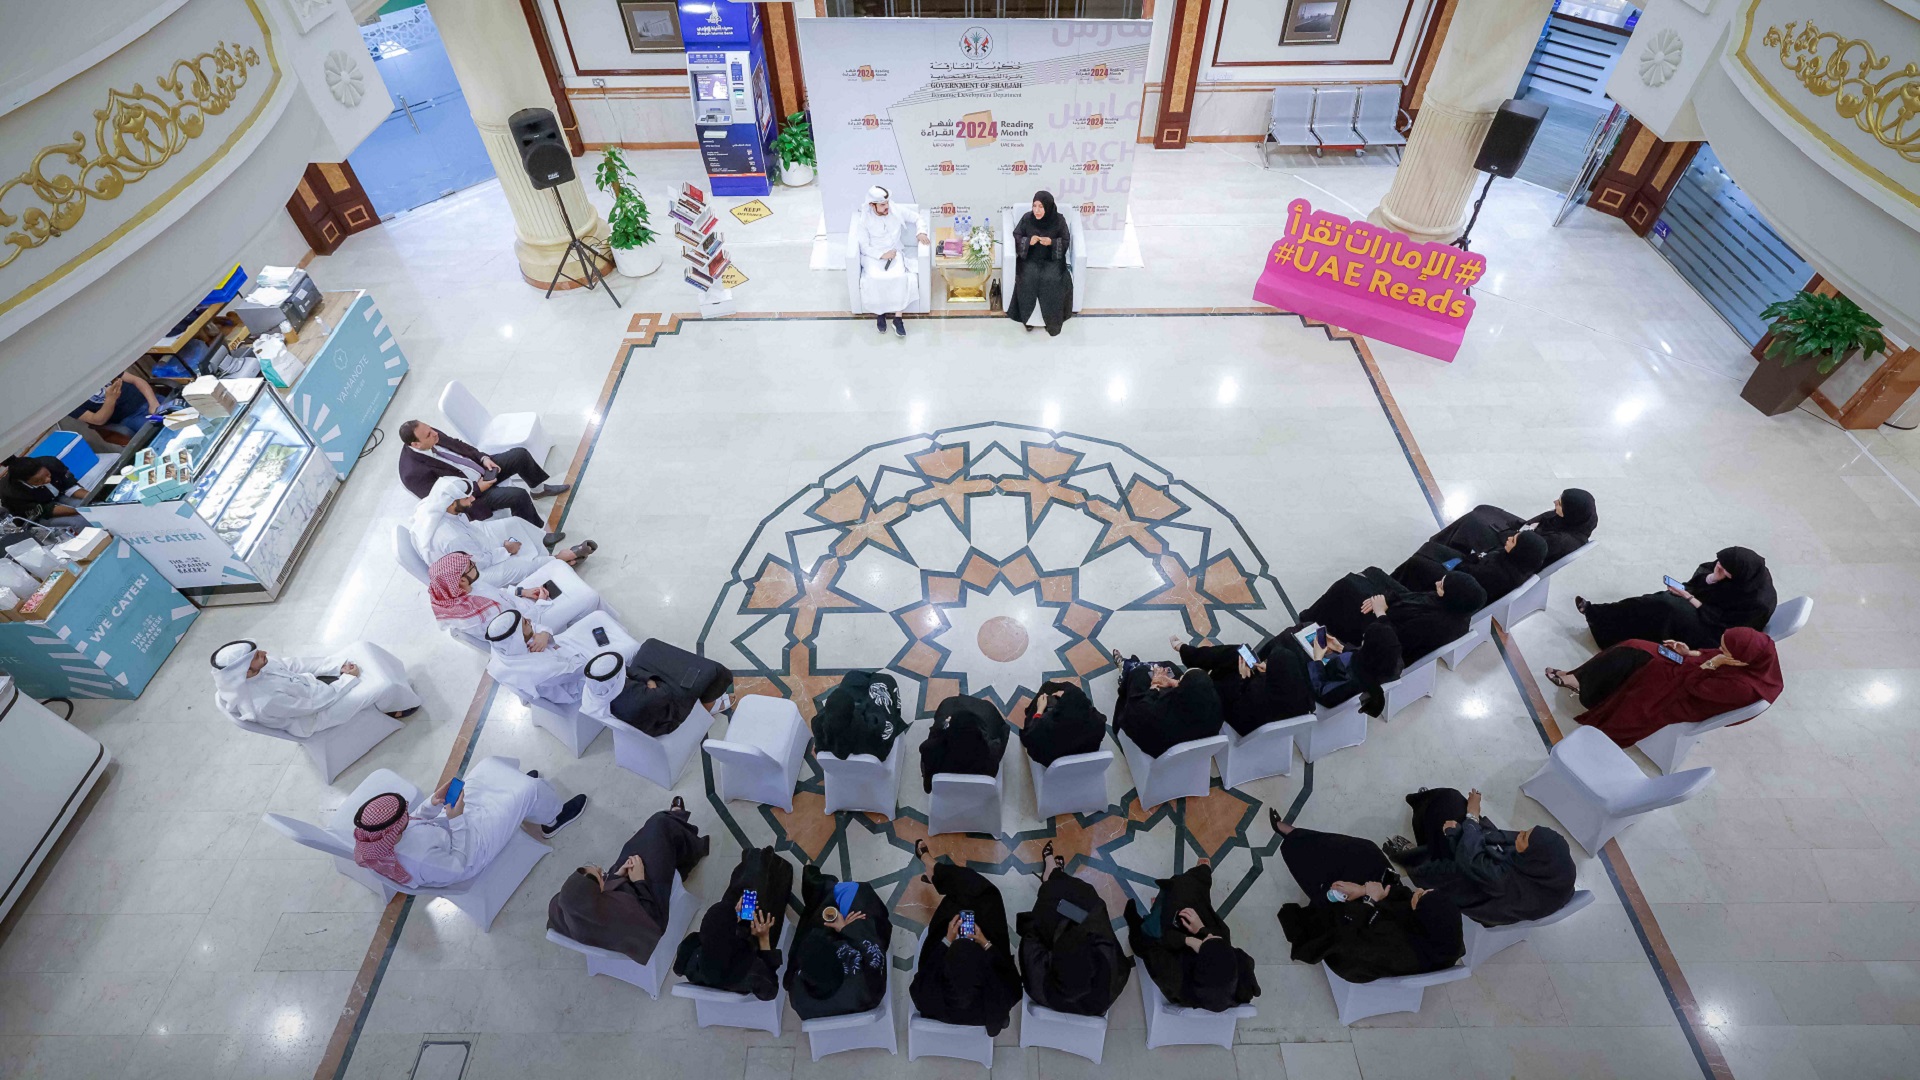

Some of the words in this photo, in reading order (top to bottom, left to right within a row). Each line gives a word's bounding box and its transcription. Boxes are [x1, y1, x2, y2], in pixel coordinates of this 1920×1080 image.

[856, 69, 875, 78] 2024
[1090, 68, 1109, 77] 2024
[1048, 93, 1142, 129] مارس
[861, 118, 879, 126] 2024
[929, 119, 954, 129] شهر
[1000, 121, 1034, 130] Reading
[1086, 117, 1104, 126] 2024
[920, 128, 954, 138] القراءة
[955, 121, 998, 139] 2024
[1000, 129, 1029, 137] Month
[1031, 141, 1135, 163] MARCH
[866, 164, 884, 172] 2024
[938, 164, 955, 172] 2024
[1011, 164, 1028, 172] 2024
[1082, 163, 1100, 172] 2024
[940, 206, 956, 215] 2024
[1079, 205, 1096, 214] 2024
[1290, 204, 1348, 248] تقرأ
[1344, 229, 1482, 286] #الإمارات
[1274, 242, 1365, 288] #UAE
[1368, 268, 1467, 318] Reads
[336, 354, 369, 405] YAMANOTE
[127, 535, 152, 546] WE
[153, 532, 207, 543] CATER!
[174, 561, 212, 569] JAPANESE
[89, 618, 113, 643] WE
[111, 573, 150, 617] CATER!
[137, 615, 164, 650] JAPANESE
[131, 631, 144, 646] THE
[140, 627, 162, 654] BAKERS
